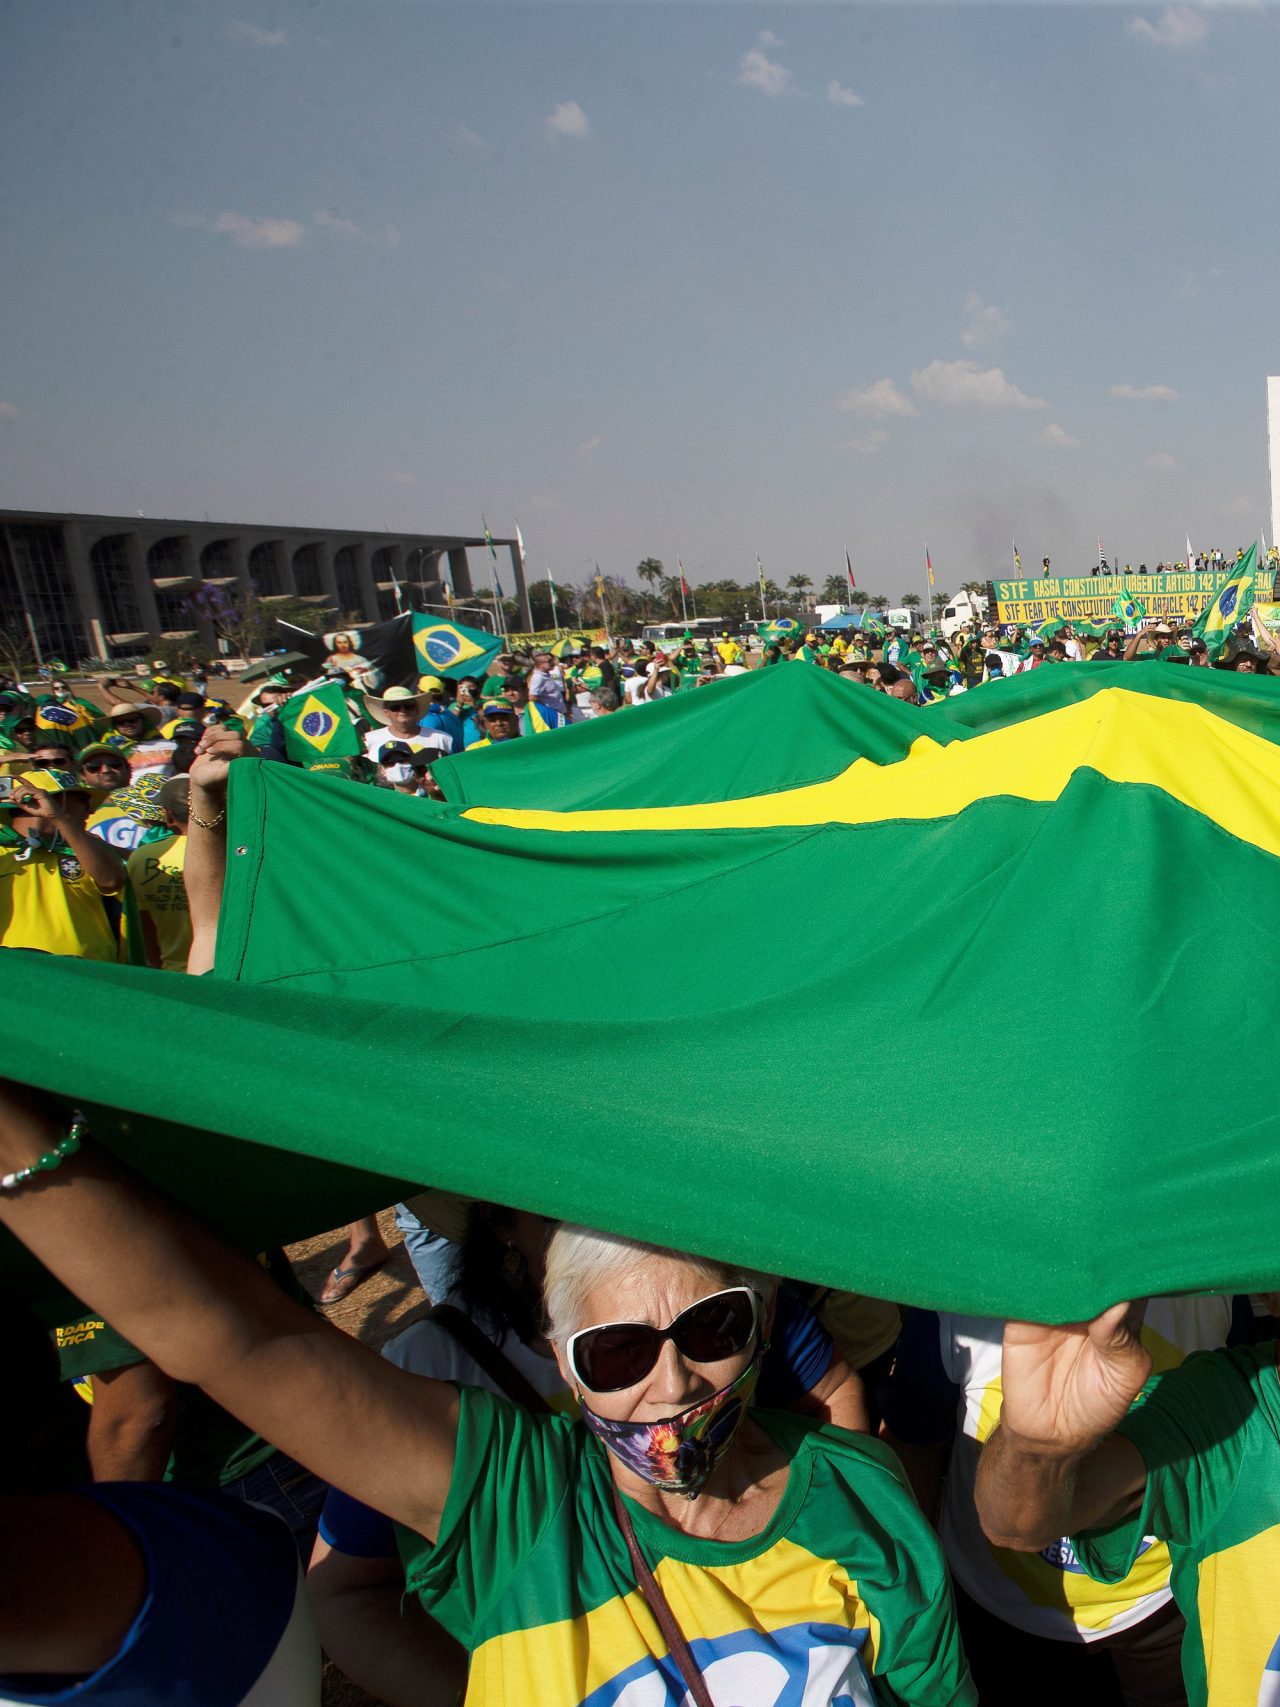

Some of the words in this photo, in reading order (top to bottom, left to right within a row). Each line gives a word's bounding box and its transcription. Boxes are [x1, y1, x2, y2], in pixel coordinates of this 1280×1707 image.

[999, 581, 1028, 600] STF
[1033, 579, 1061, 597] RASGA
[1126, 575, 1162, 593] URGENTE
[1166, 573, 1196, 592] ARTIGO
[1199, 573, 1213, 591] 142
[1255, 572, 1272, 589] ERAL
[1005, 602, 1020, 621] STF
[1023, 601, 1043, 619] TEAR
[1045, 600, 1059, 618] THE
[1186, 595, 1198, 612] 142
[55, 1321, 105, 1337] RDADE
